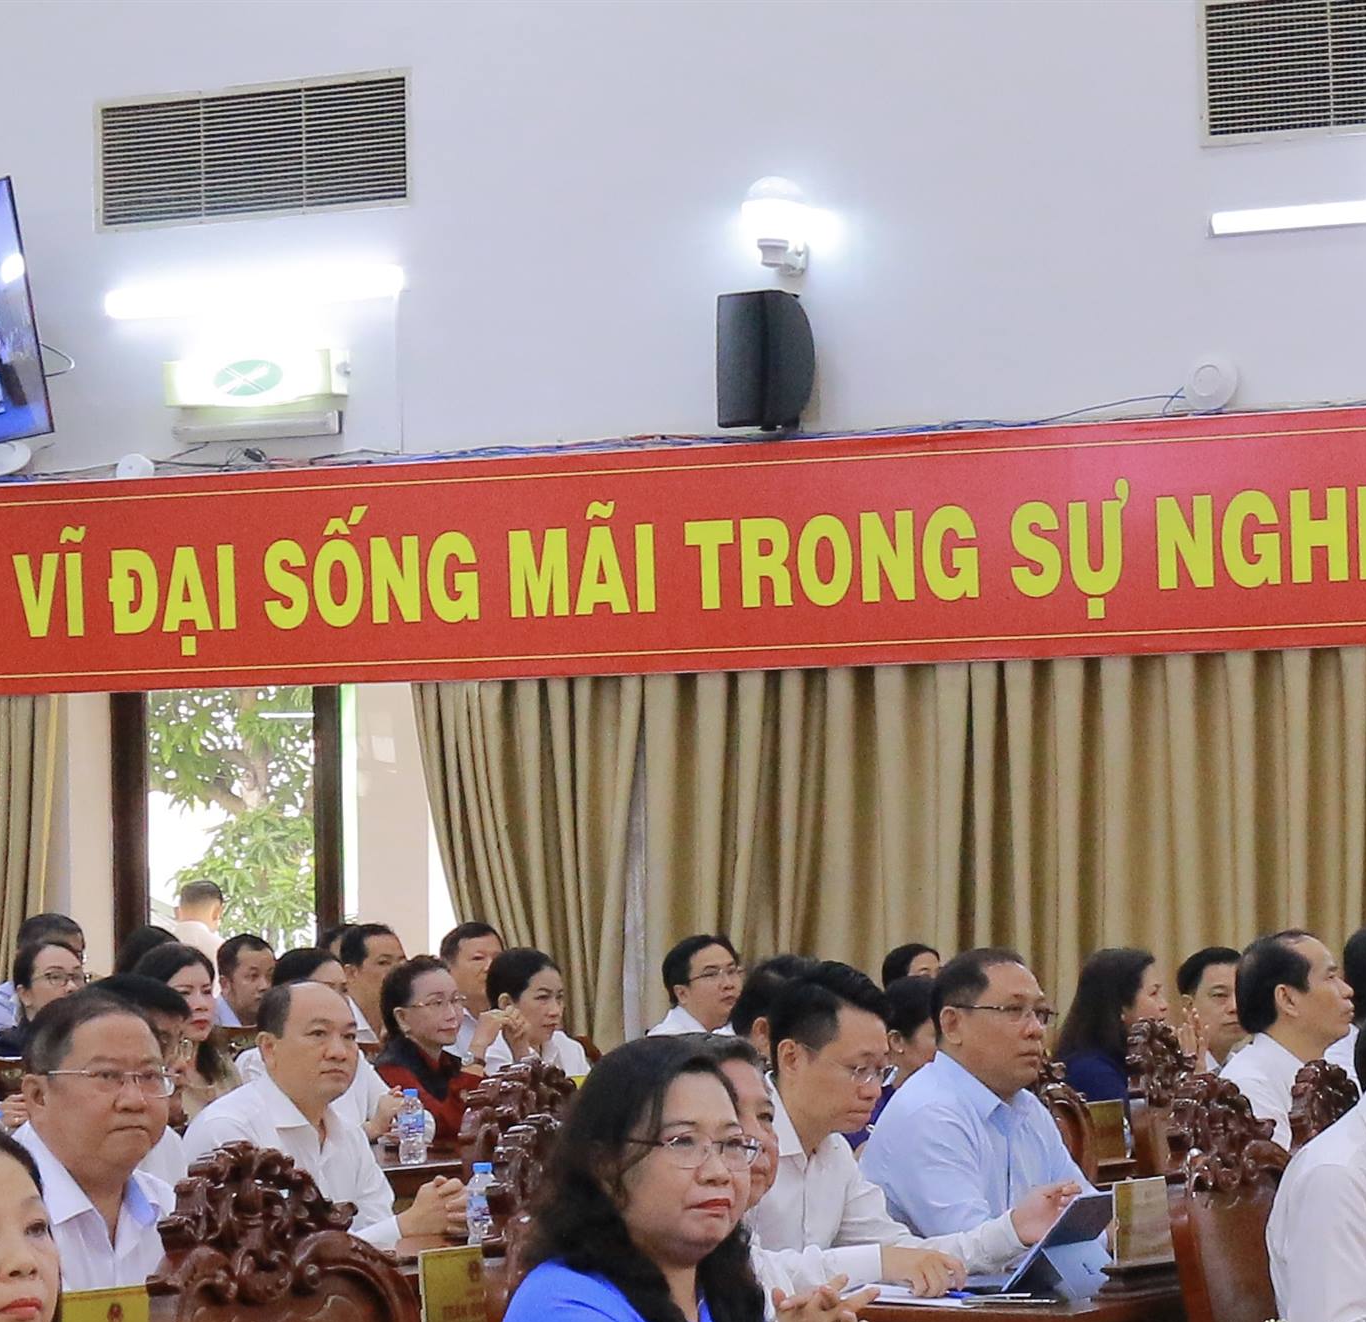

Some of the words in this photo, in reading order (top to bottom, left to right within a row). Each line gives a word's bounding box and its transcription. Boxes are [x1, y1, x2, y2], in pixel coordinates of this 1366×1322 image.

[12, 526, 86, 638] VĨ
[108, 544, 237, 656] ĐẠI
[264, 505, 480, 630] SỐNG
[508, 501, 656, 618] MÃI
[684, 505, 980, 610] TRONG
[1010, 478, 1130, 619] SỰ
